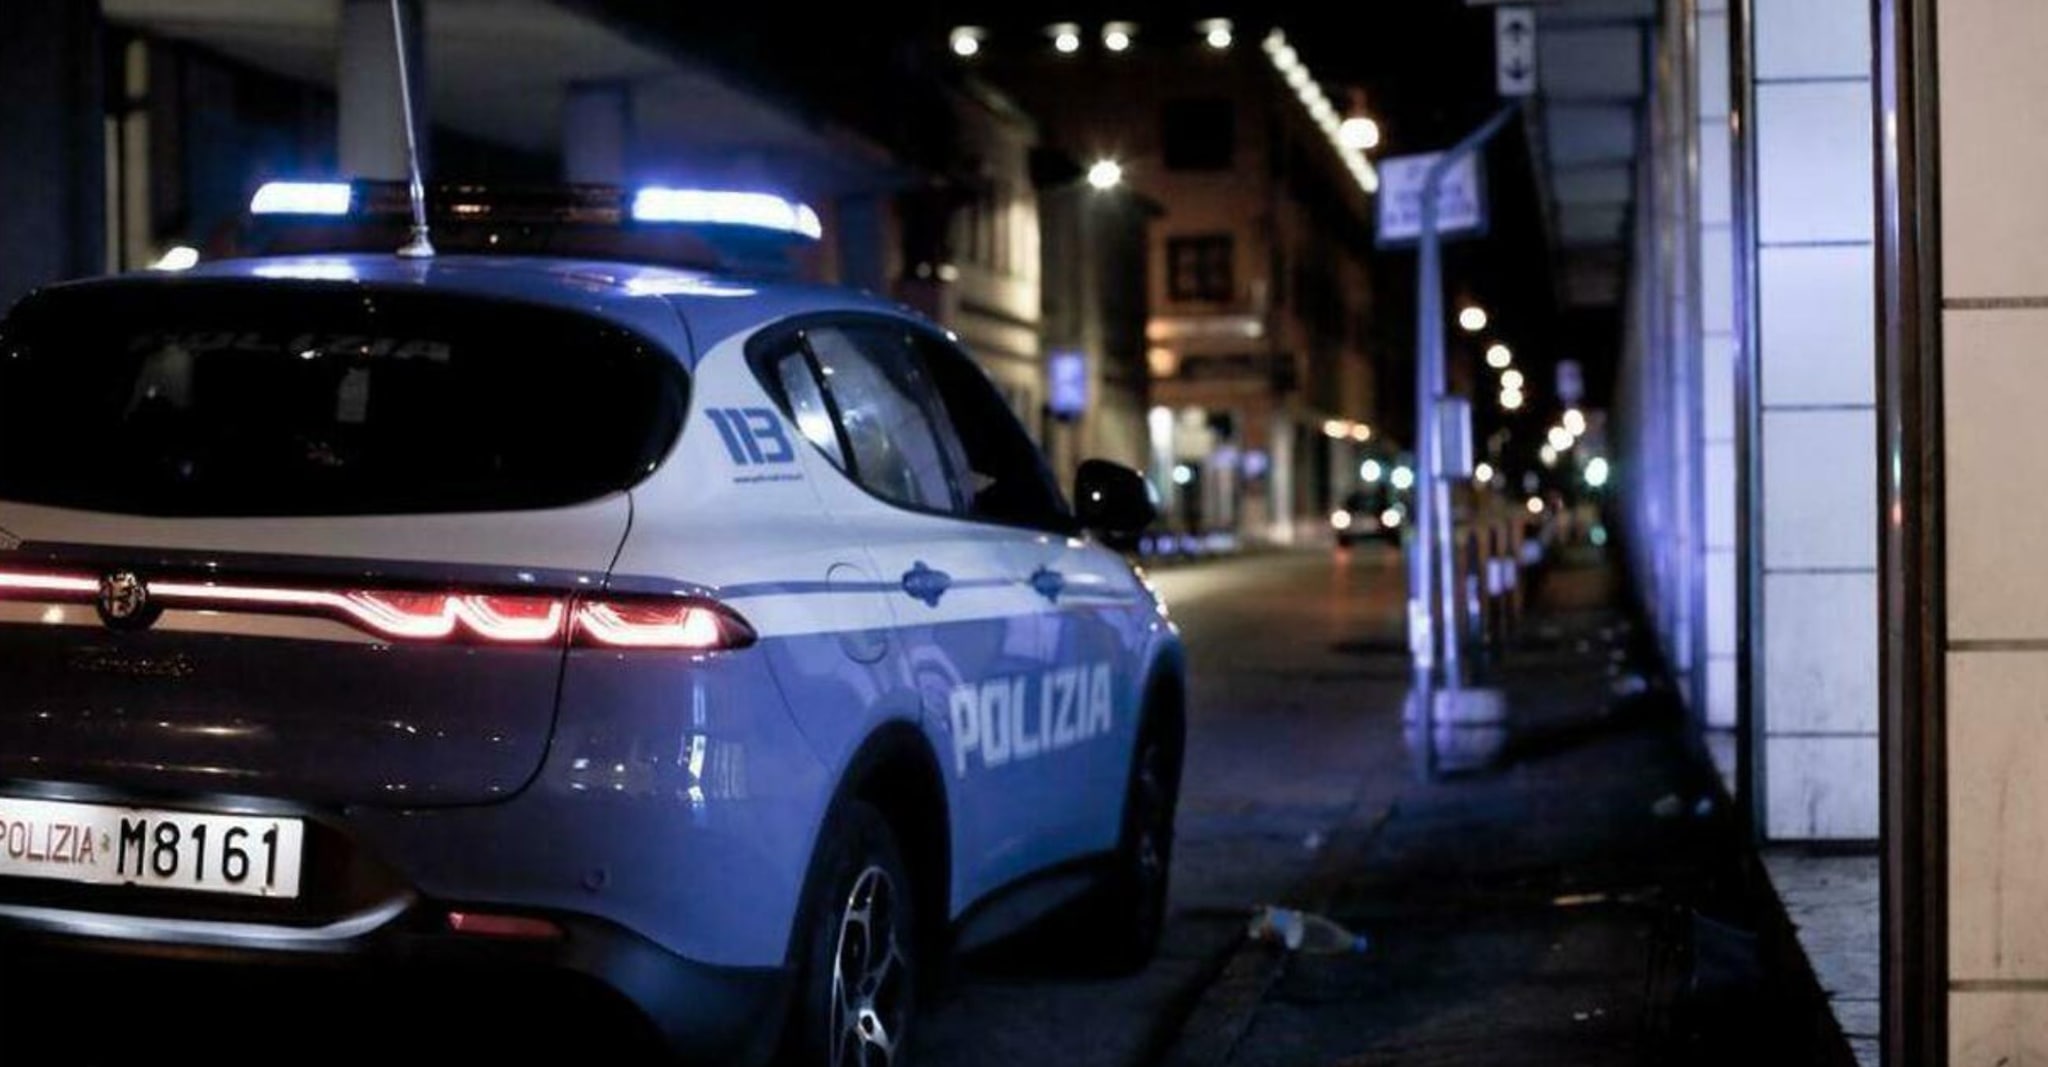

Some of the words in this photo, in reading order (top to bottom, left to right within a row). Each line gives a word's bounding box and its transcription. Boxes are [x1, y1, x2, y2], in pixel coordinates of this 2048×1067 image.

[704, 408, 794, 465] 113
[951, 663, 1111, 779] POLIZIA
[117, 818, 278, 886] M8161
